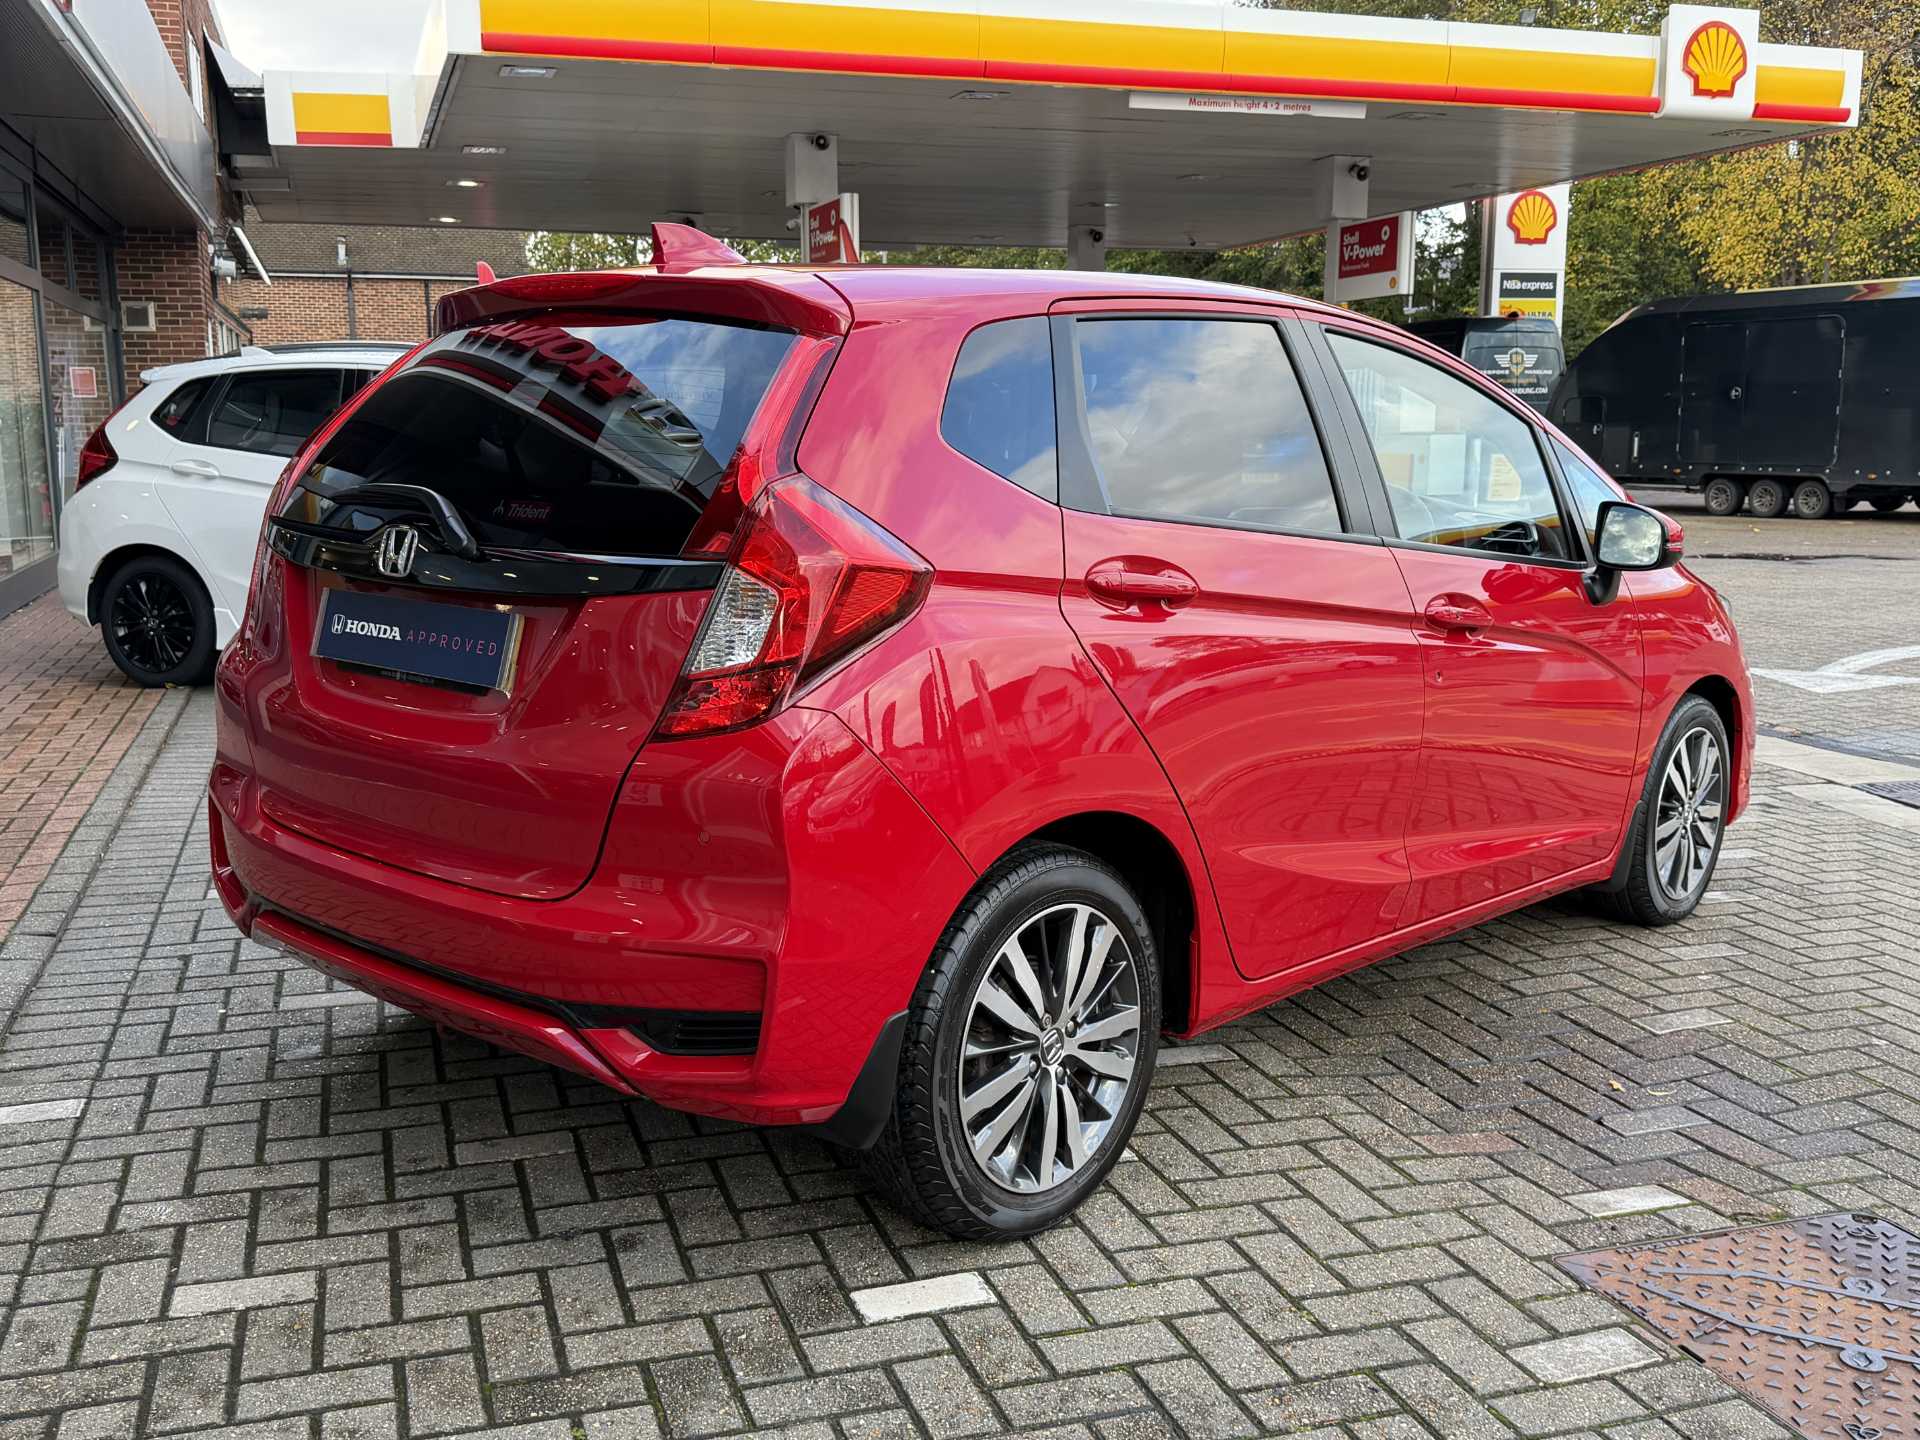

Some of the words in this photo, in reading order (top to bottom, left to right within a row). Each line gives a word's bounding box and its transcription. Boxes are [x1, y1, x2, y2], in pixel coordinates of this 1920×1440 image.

[1188, 97, 1231, 107] Maximum
[1283, 103, 1312, 112] metres
[1343, 231, 1360, 245] Shell
[1343, 243, 1386, 262] V-Power
[508, 503, 551, 520] Trident
[345, 619, 402, 641] HONDA
[405, 629, 497, 656] APPROVED
